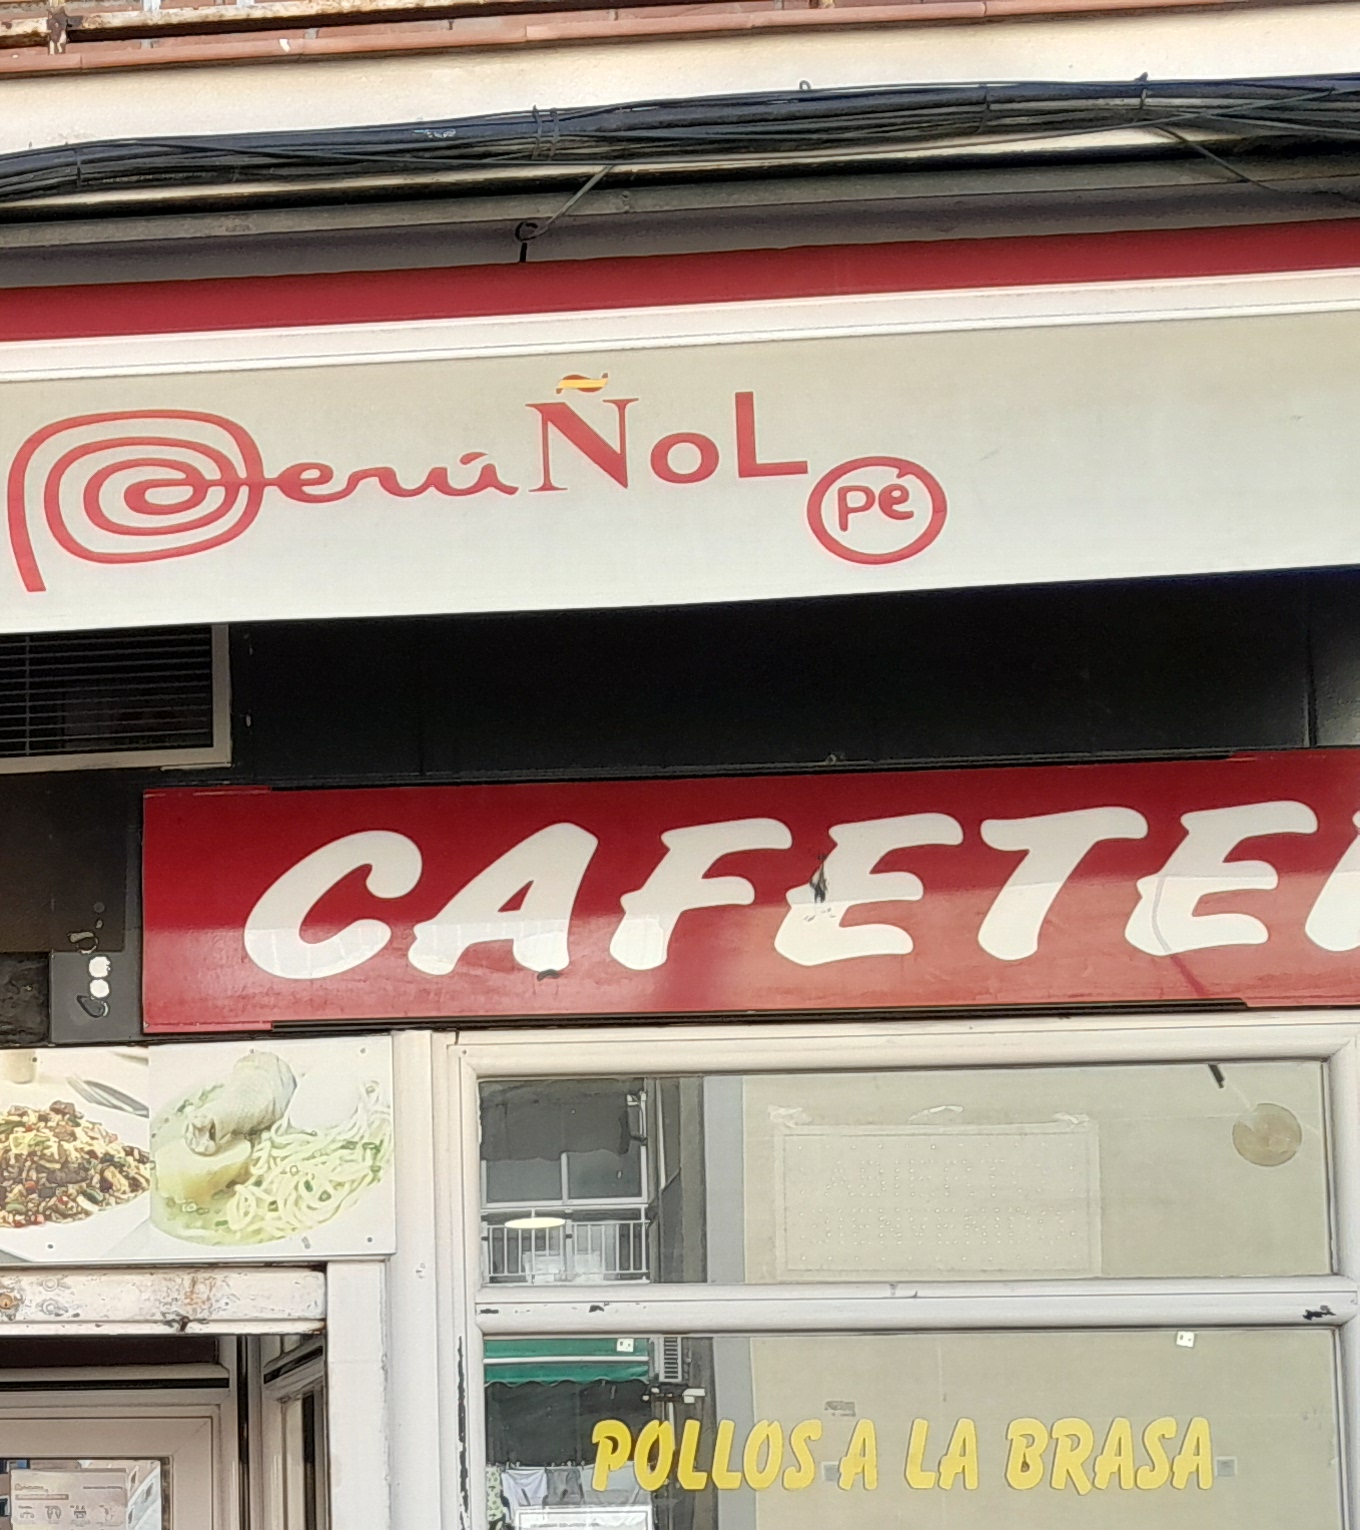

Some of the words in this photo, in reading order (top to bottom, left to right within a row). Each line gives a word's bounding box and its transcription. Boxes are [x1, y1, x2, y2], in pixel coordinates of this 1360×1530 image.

[591, 1418, 824, 1493] POLLOS
[837, 1418, 879, 1492] A
[905, 1418, 980, 1492] LA
[1006, 1416, 1215, 1496] BRASA
